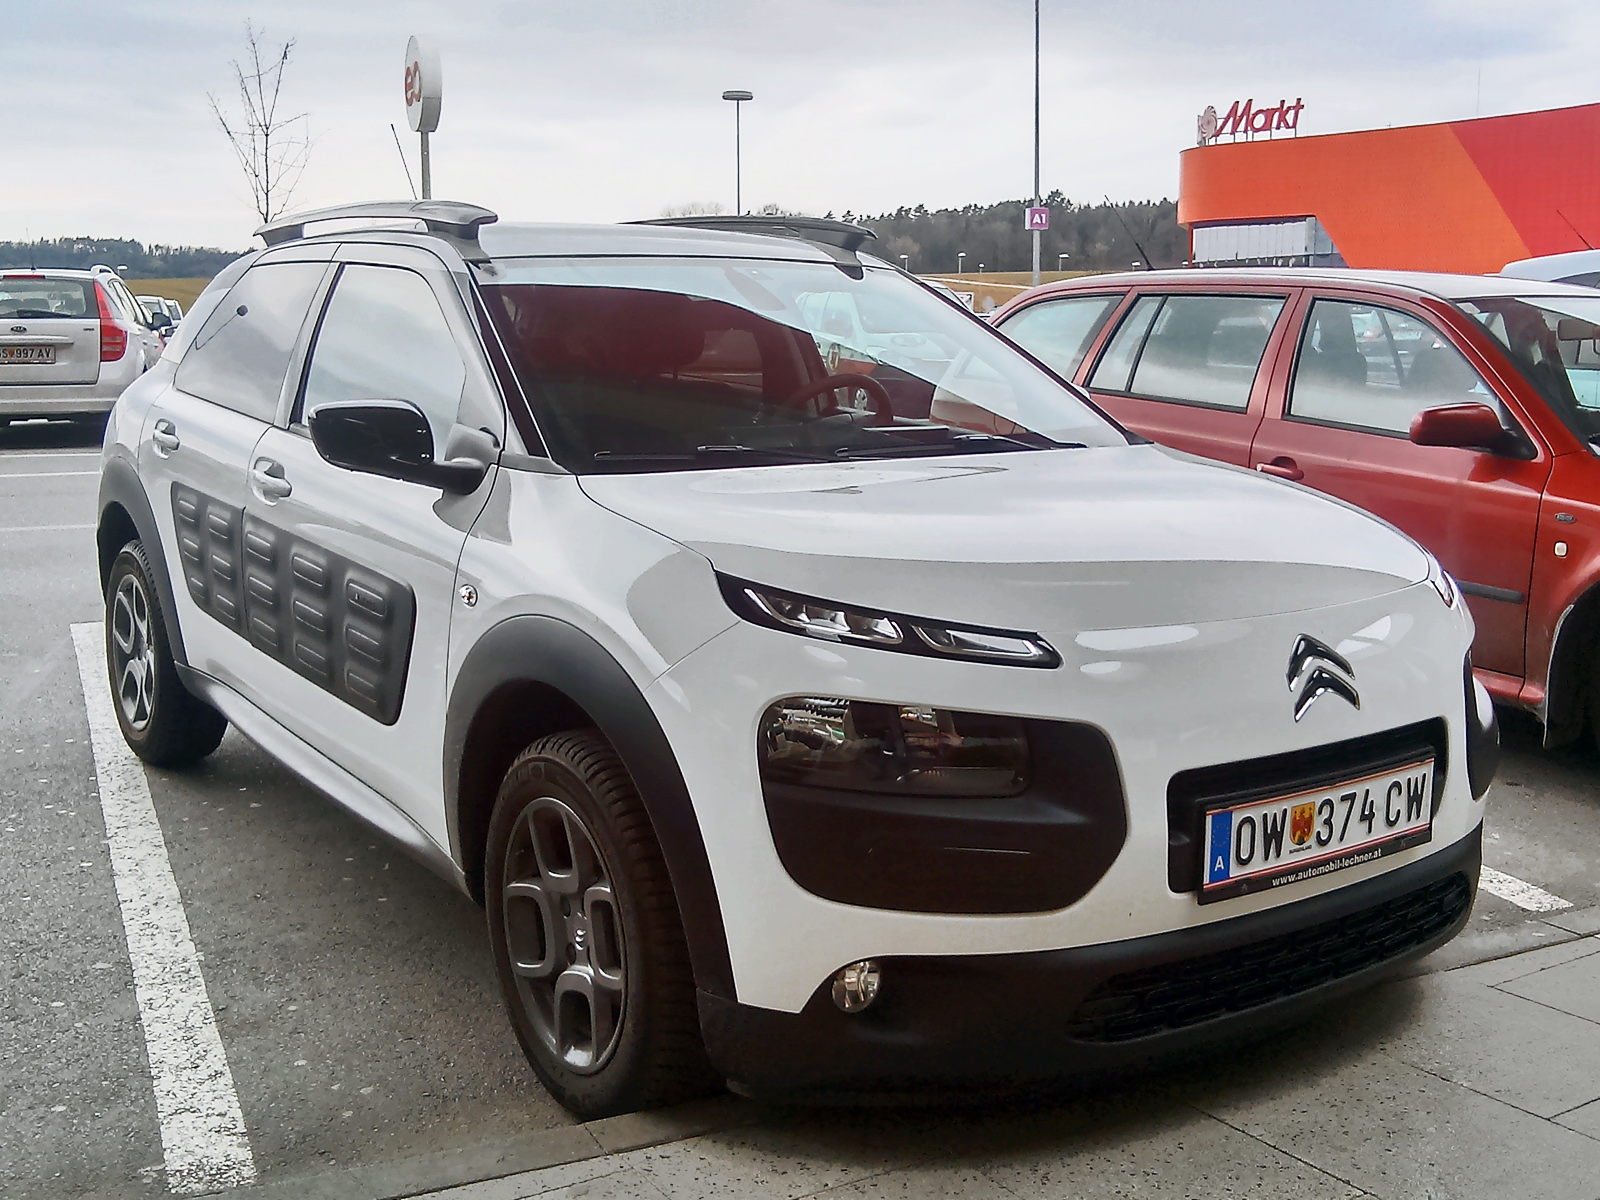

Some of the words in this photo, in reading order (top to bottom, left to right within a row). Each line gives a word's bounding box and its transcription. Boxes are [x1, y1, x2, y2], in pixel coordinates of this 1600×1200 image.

[1209, 98, 1304, 138] Markt
[1032, 213, 1046, 224] A1
[16, 348, 35, 358] 997
[37, 348, 51, 358] AV
[1235, 808, 1288, 866] OW
[1315, 788, 1375, 847] 374
[1385, 773, 1427, 828] CW
[1214, 855, 1225, 872] A
[1272, 848, 1382, 886] www.automobil-lechner.at
